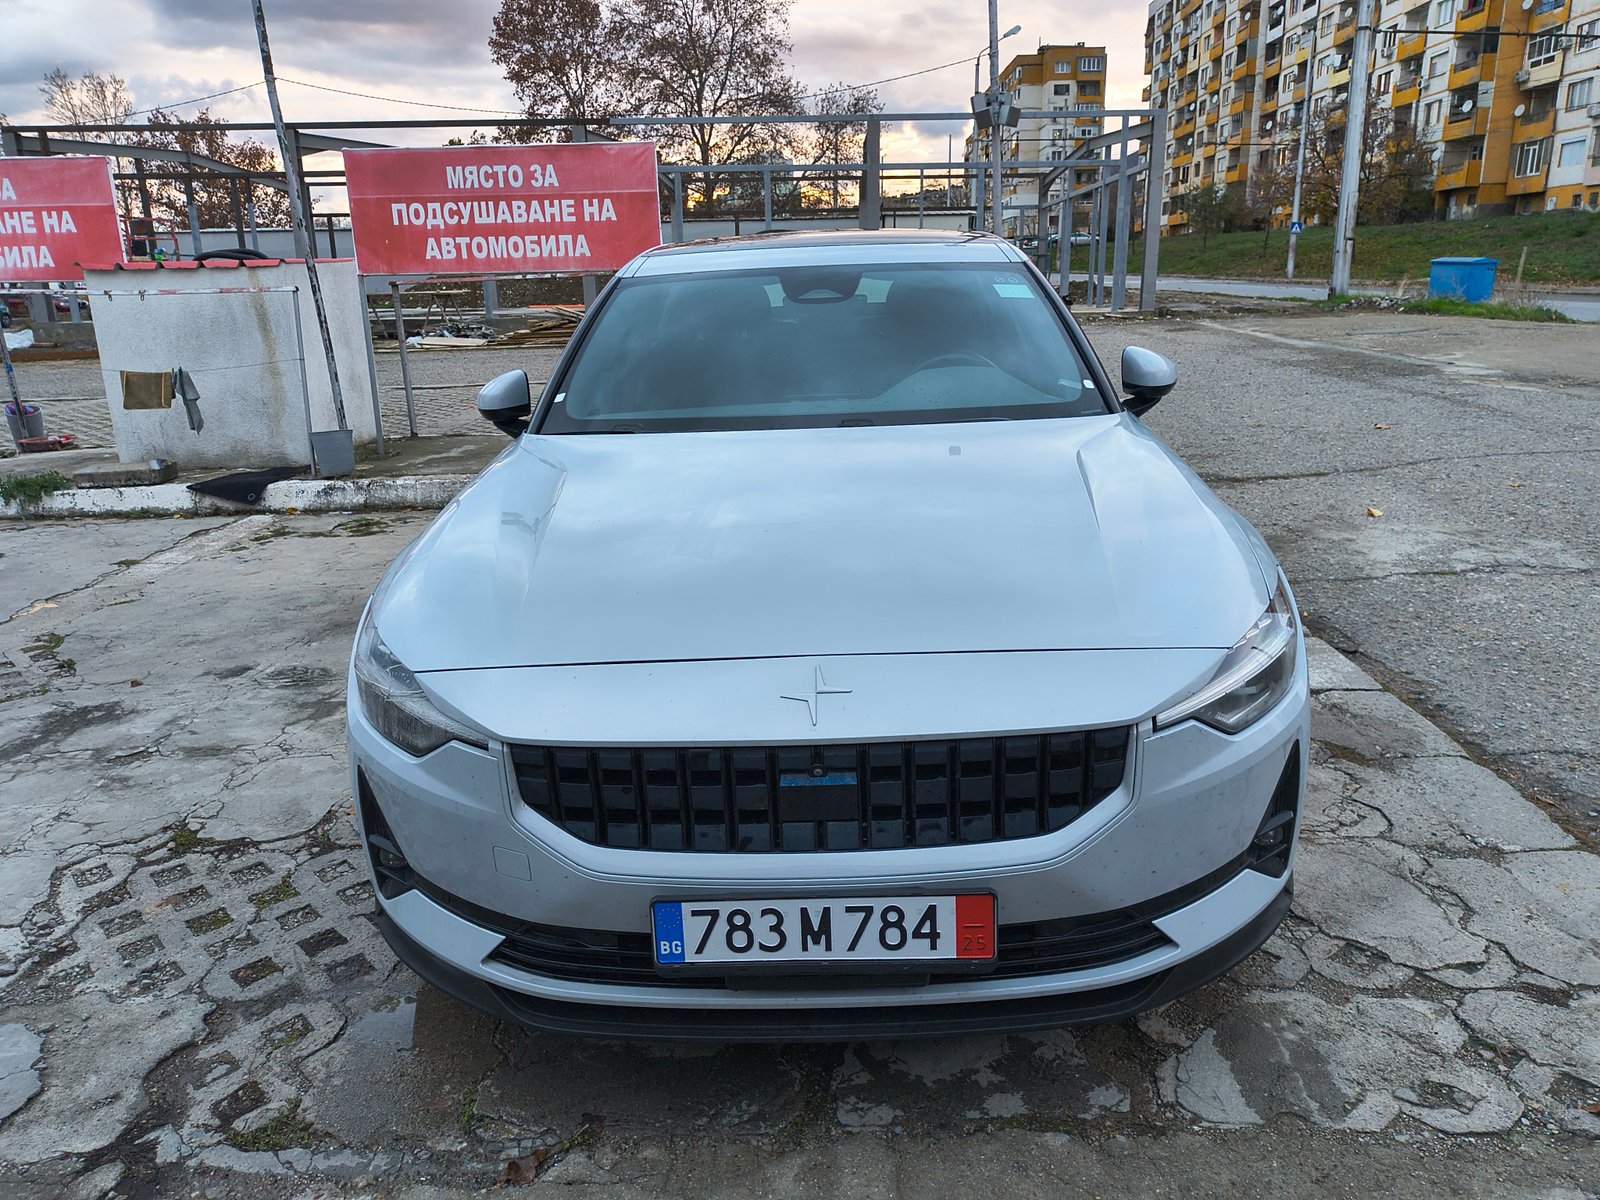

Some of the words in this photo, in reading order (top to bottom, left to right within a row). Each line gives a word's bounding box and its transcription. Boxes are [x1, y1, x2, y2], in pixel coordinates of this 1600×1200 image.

[446, 165, 524, 189] МЯСТО
[530, 164, 559, 188] ЗА
[0, 178, 17, 200] А
[41, 210, 78, 233] НА
[391, 199, 577, 229] ПОДСУШАВАНЕ
[583, 198, 617, 222] НА
[425, 234, 591, 260] АВТОМОБИЛА
[661, 940, 682, 955] BG
[963, 934, 986, 951] 25
